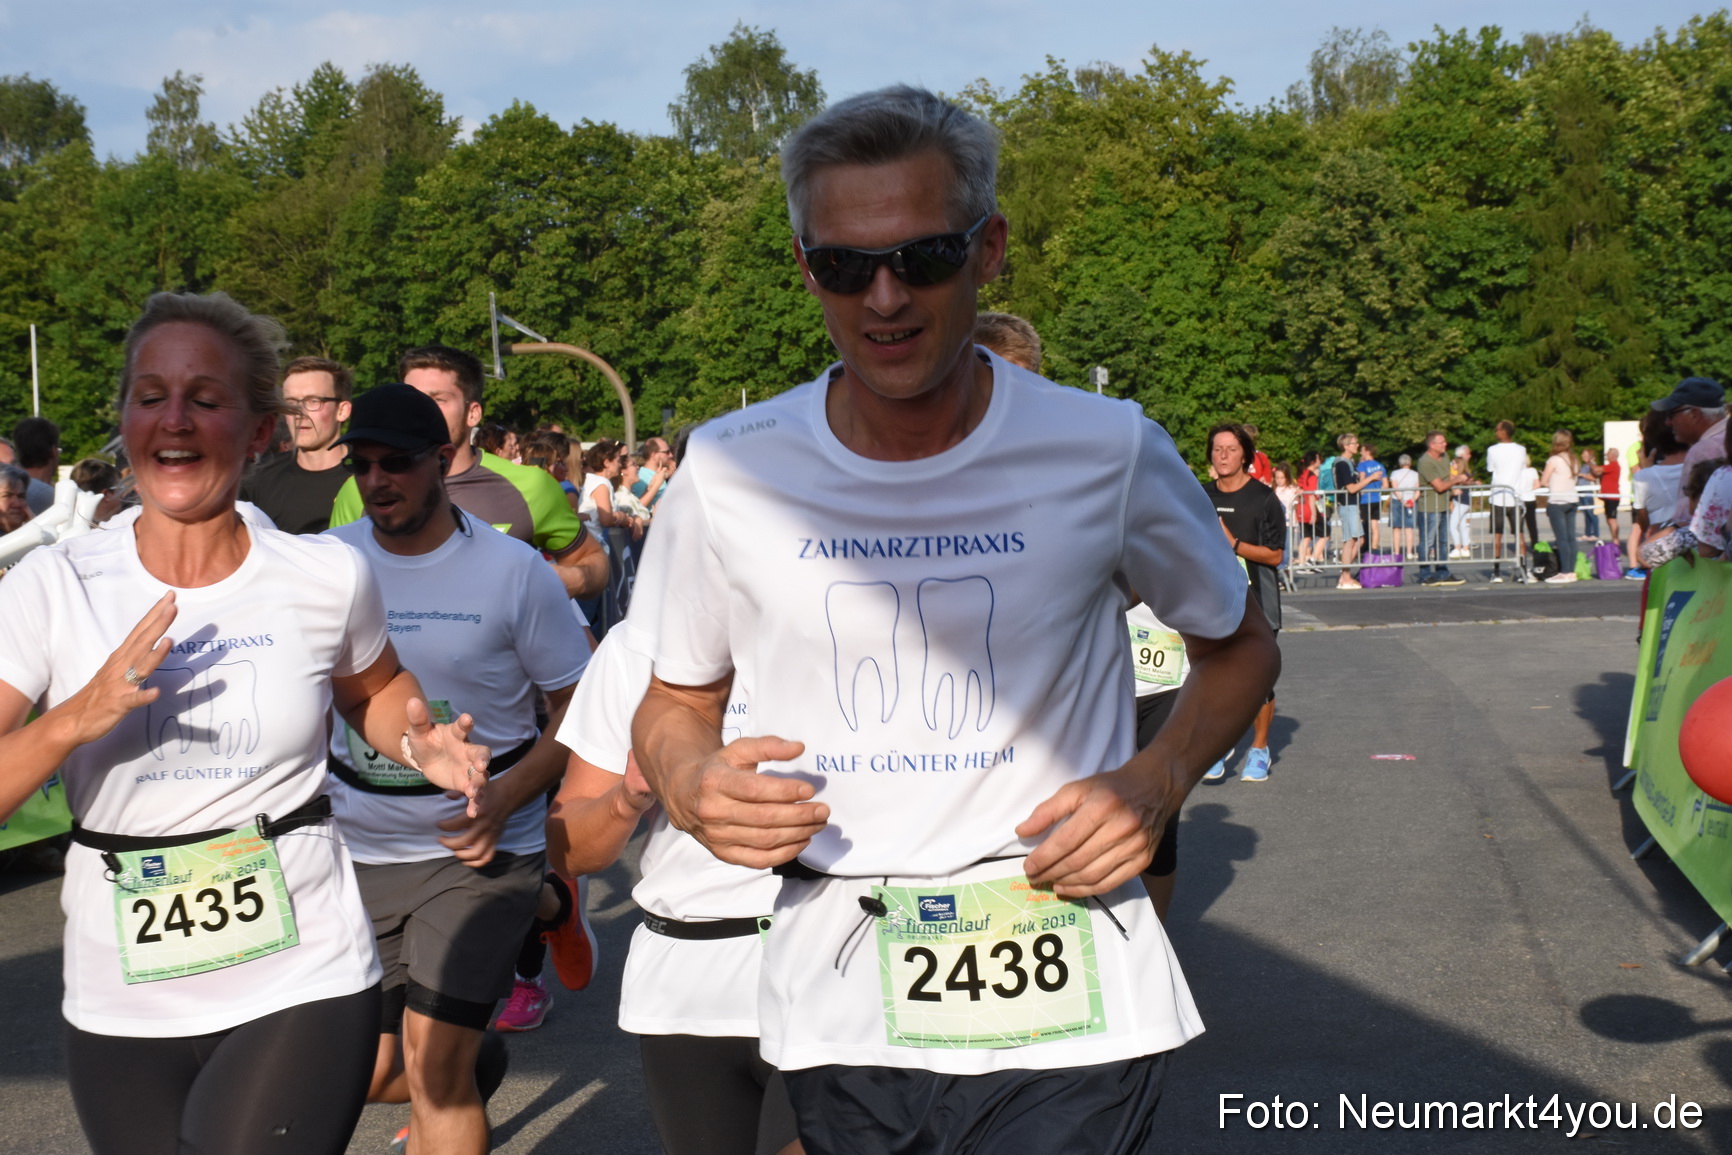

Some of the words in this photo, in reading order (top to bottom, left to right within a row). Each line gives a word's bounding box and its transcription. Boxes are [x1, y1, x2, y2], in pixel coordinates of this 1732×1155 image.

[739, 418, 777, 435] JAKO
[798, 531, 1026, 560] ZAHNARZTPRAXIS
[387, 610, 482, 625] Breitbandberatung
[387, 622, 421, 634] Bayern
[1139, 647, 1165, 668] 90
[816, 753, 863, 772] RALF
[870, 750, 957, 773] GÜNTER
[135, 770, 169, 784] RALF
[173, 766, 233, 781] GÜNTER
[237, 859, 267, 877] 2019
[132, 875, 264, 944] 2435
[906, 914, 992, 934] firmenlauf
[1041, 912, 1077, 931] 2019
[904, 933, 1069, 1002] 2438
